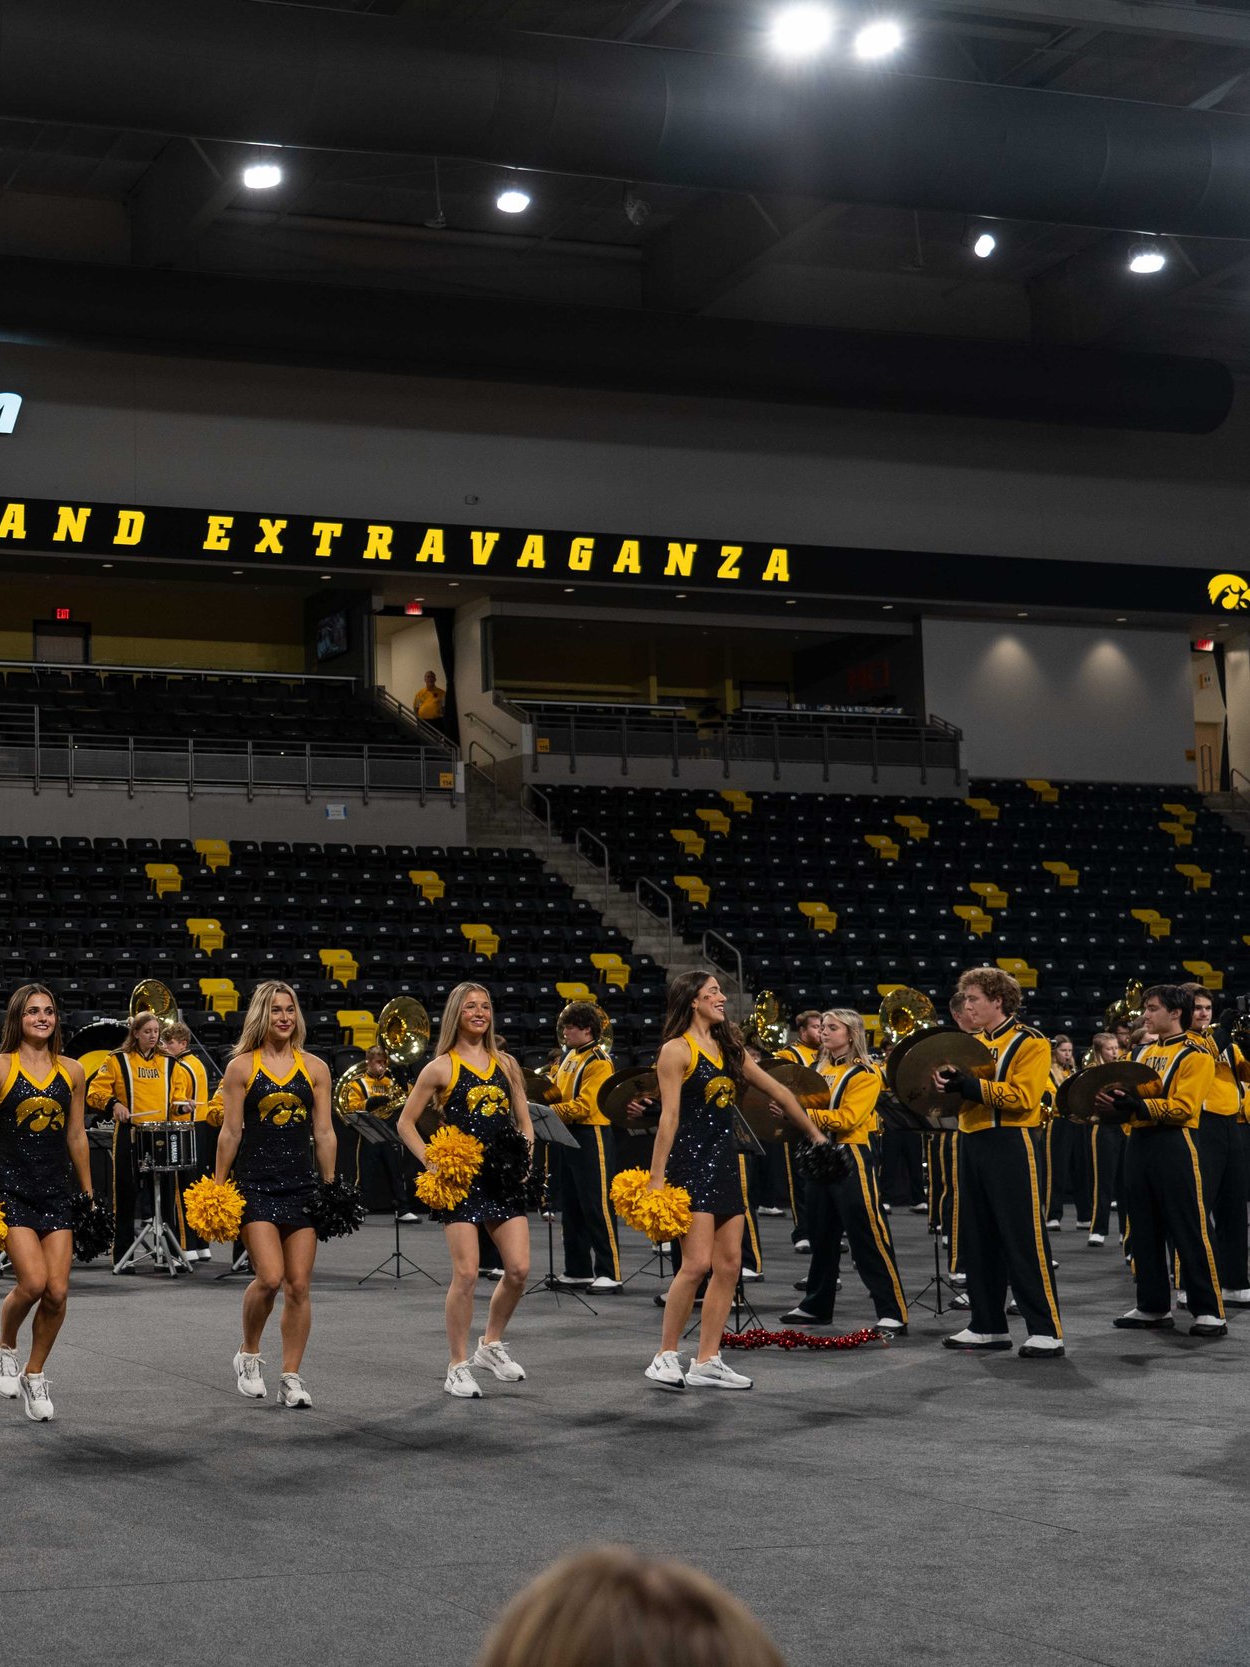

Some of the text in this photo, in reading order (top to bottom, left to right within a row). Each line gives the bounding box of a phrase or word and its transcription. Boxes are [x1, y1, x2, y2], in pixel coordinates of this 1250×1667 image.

[202, 515, 790, 582] EXTRAVAGANZA
[56, 608, 70, 620] EXIT
[138, 1066, 160, 1079] IOWA
